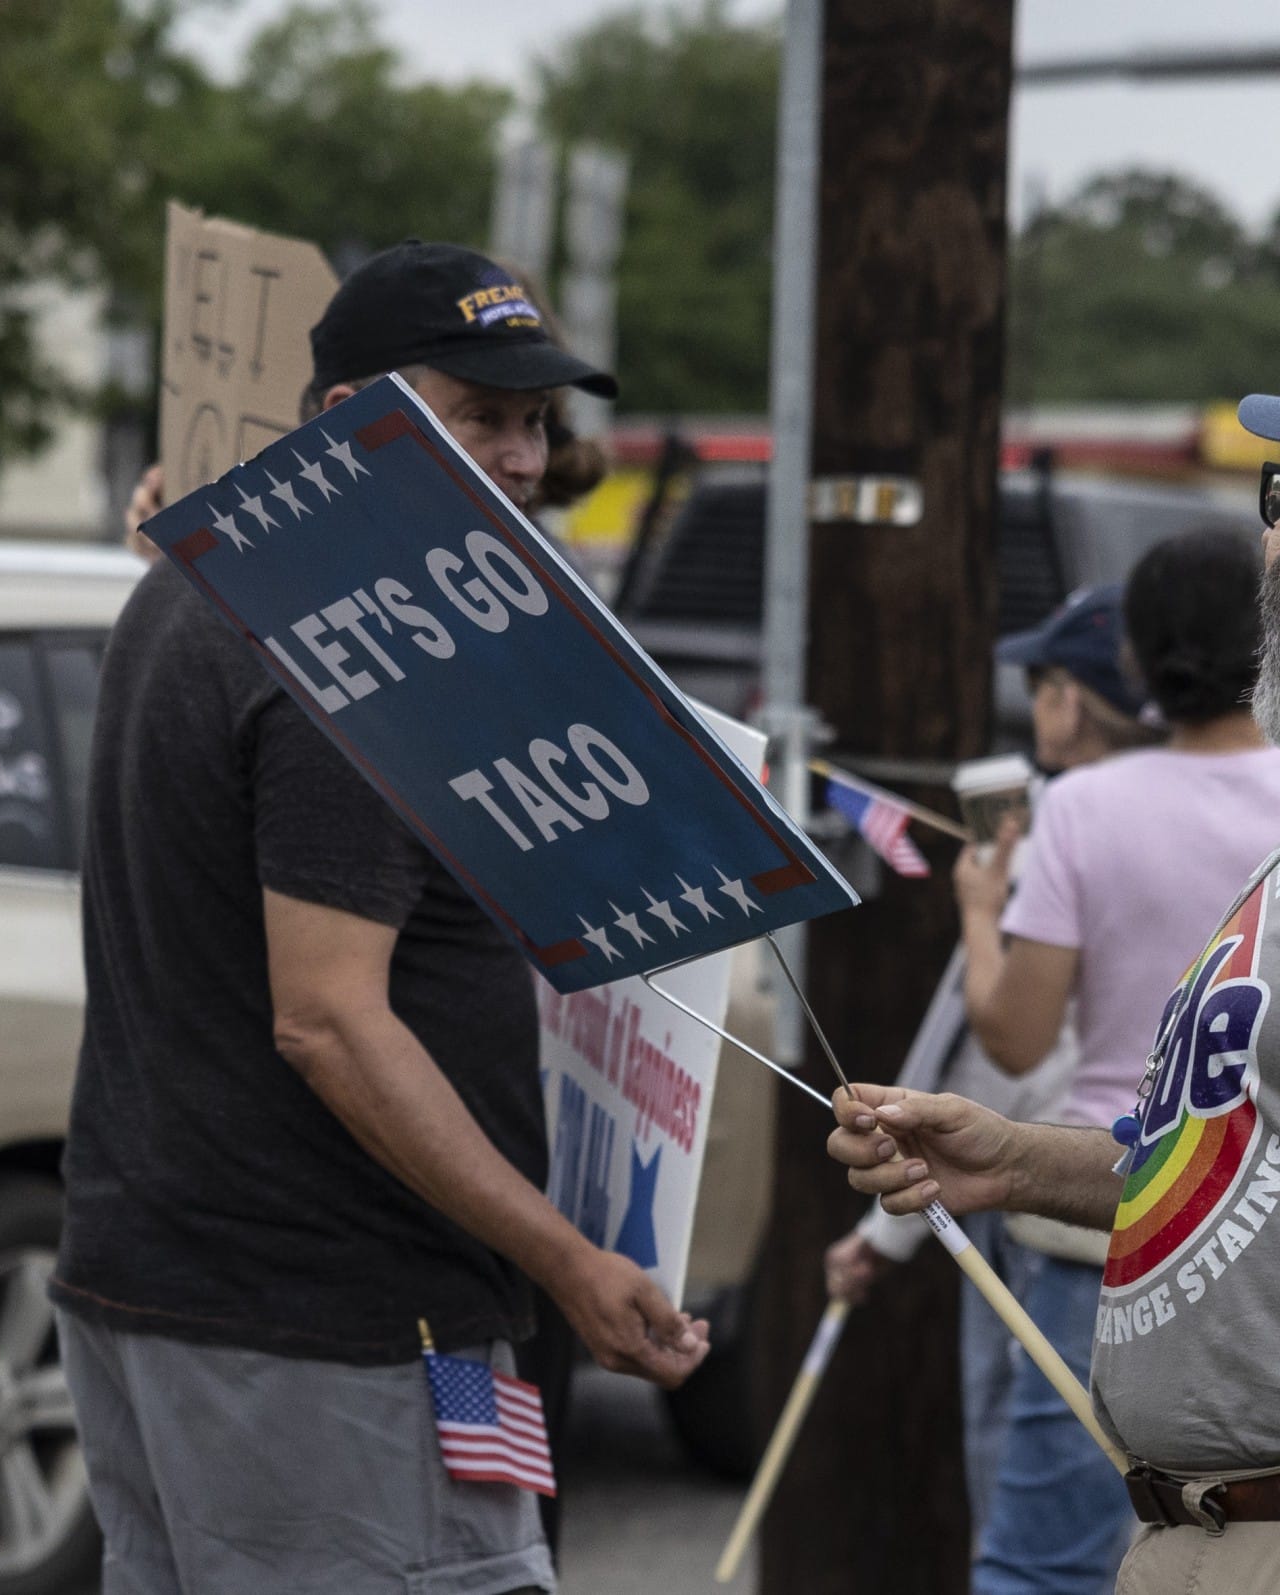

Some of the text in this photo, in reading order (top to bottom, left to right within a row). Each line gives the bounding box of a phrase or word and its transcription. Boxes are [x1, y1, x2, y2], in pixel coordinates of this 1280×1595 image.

[264, 529, 550, 715] LET'S GO
[447, 722, 651, 852] TACO
